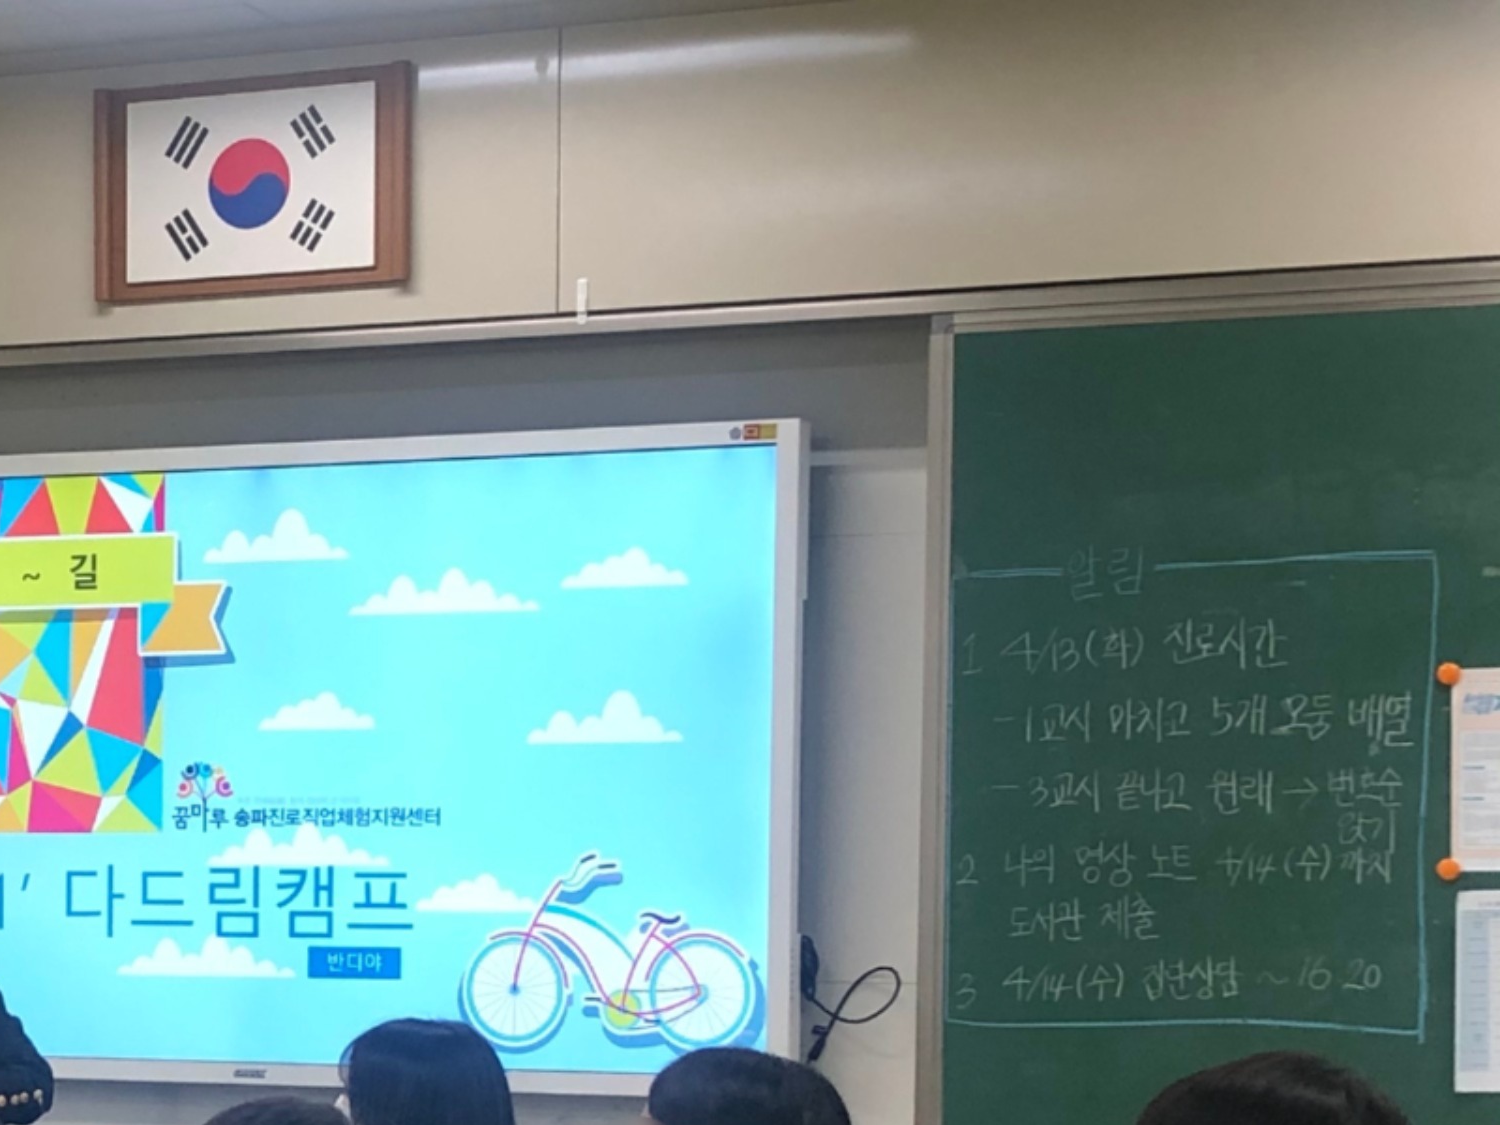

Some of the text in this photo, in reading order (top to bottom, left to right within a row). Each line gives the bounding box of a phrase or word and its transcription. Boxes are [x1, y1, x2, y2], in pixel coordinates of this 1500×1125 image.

[69, 553, 98, 590] 길
[1067, 545, 1145, 601] 알림
[1001, 626, 1144, 675] 4/13(화)
[1163, 616, 1289, 670] 진로시간
[1109, 699, 1191, 743] 마치고
[1210, 694, 1268, 736] 5개
[1348, 690, 1415, 747] 배열
[1115, 768, 1192, 812] 끝나고
[1206, 769, 1273, 815] 원래
[171, 803, 442, 833] 꿈마루 송파진로직업체험지원센터
[955, 853, 979, 885] 2
[1004, 843, 1055, 888] 나의
[1147, 844, 1198, 881] 노트
[65, 863, 414, 939] 다드림캠프
[1008, 891, 1161, 942] 도서관 제출
[327, 951, 383, 973] 반디야
[956, 973, 977, 1010] 3
[1002, 963, 1125, 1003] 4/14(수)
